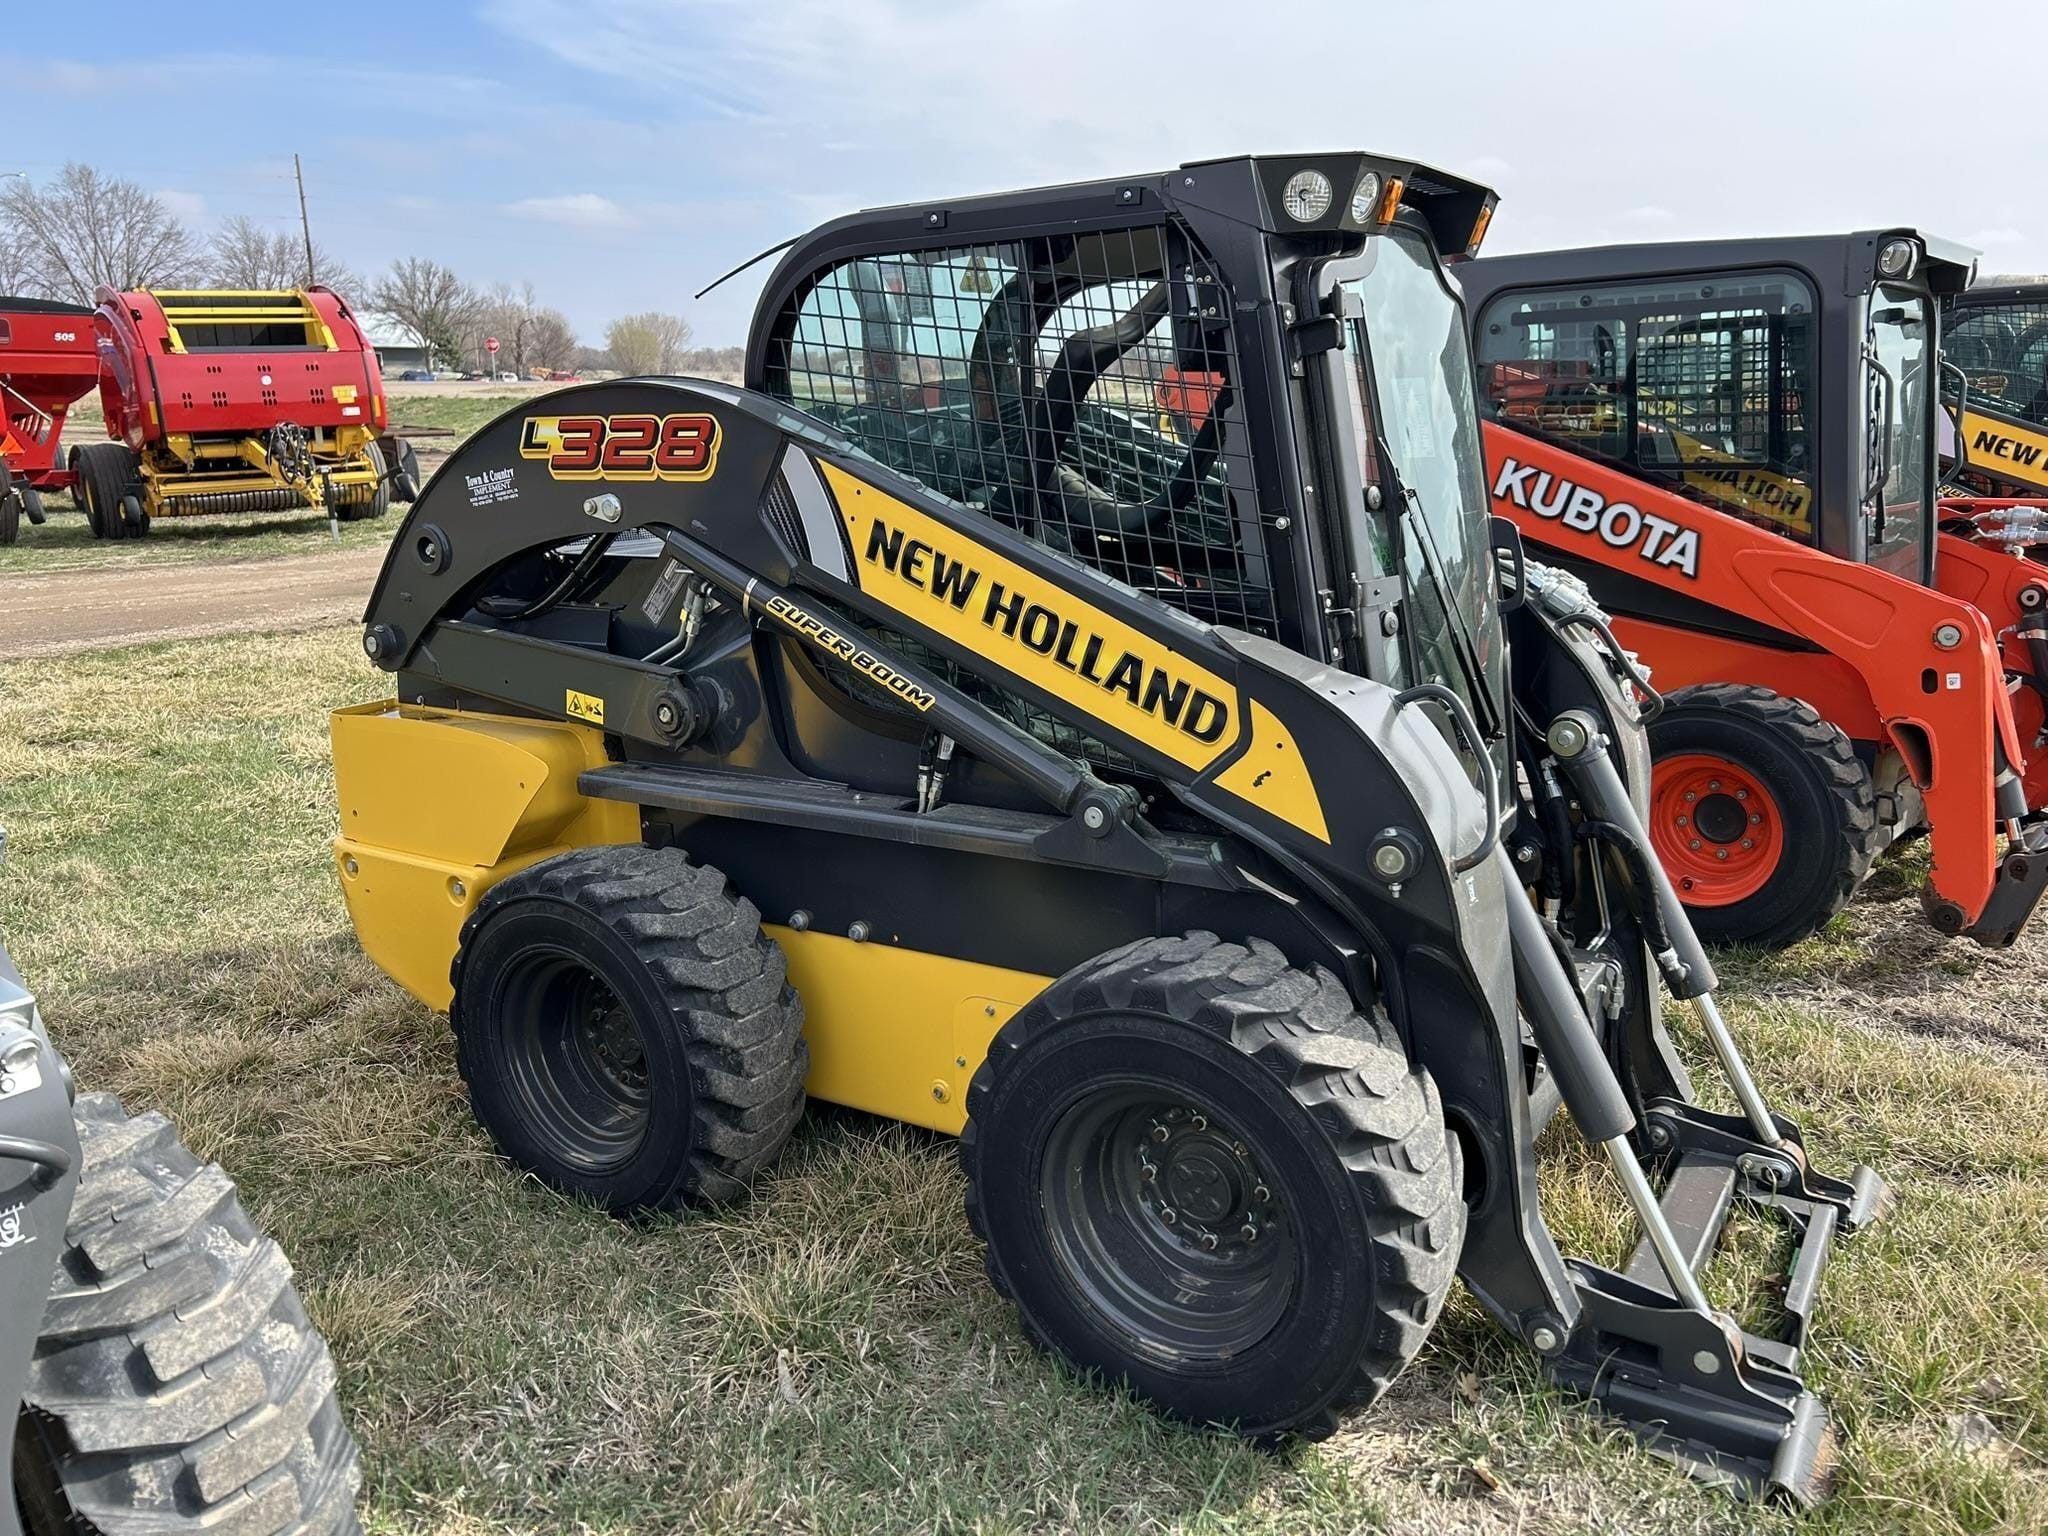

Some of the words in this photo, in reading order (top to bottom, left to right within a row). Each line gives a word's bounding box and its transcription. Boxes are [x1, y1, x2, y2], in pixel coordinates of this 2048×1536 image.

[54, 332, 76, 342] 505
[1973, 430, 2042, 466] NEW
[465, 475, 483, 487] Town
[483, 471, 490, 484] &
[489, 468, 514, 482] Country
[473, 480, 511, 496] IMPLEMENT
[1493, 457, 1700, 578] KUBOTA
[864, 516, 981, 613] NEW
[981, 580, 1230, 744] HOLLAND
[765, 595, 856, 661] SUPER
[850, 649, 937, 713] BOOM
